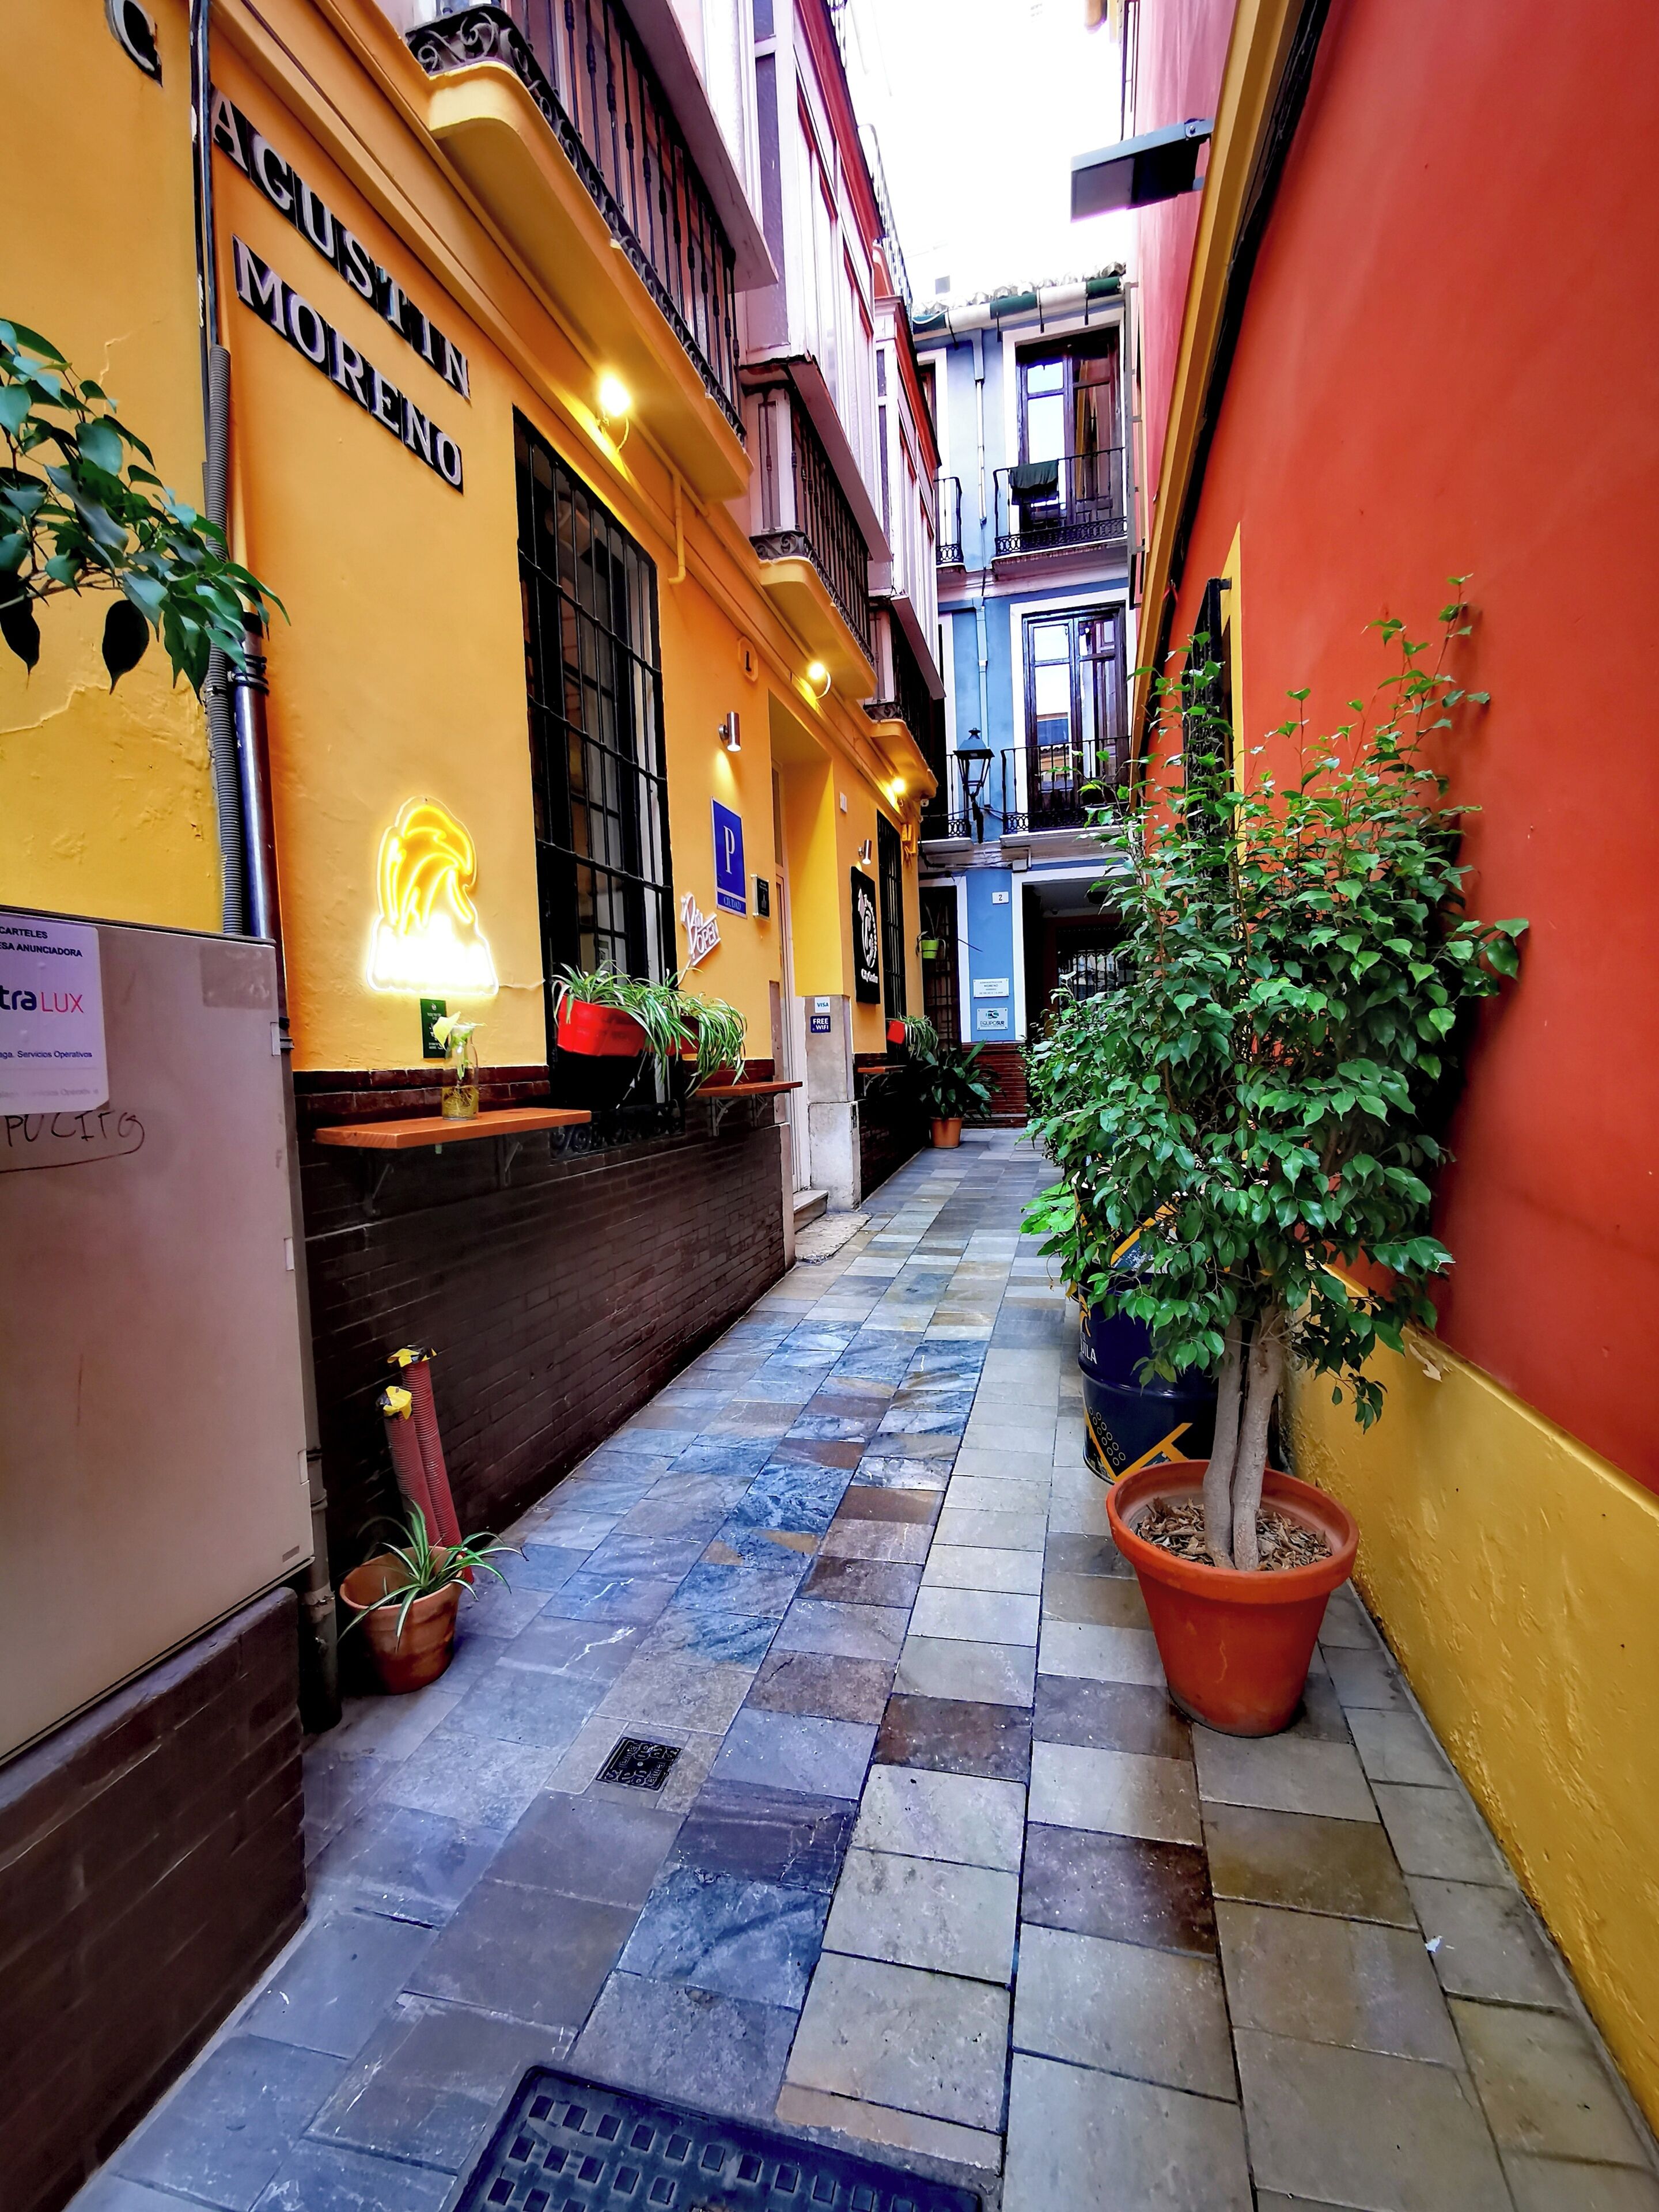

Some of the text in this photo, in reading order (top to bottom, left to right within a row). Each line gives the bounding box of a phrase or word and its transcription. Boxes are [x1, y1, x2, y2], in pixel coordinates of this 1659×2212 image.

[234, 237, 461, 486] MORENO
[723, 825, 736, 874] P
[724, 896, 741, 911] CIUDAD
[0, 926, 48, 939] CARTELES
[696, 918, 719, 955] OPEN
[17, 944, 83, 957] ANUNCIADORA
[54, 1051, 93, 1059] Operativos
